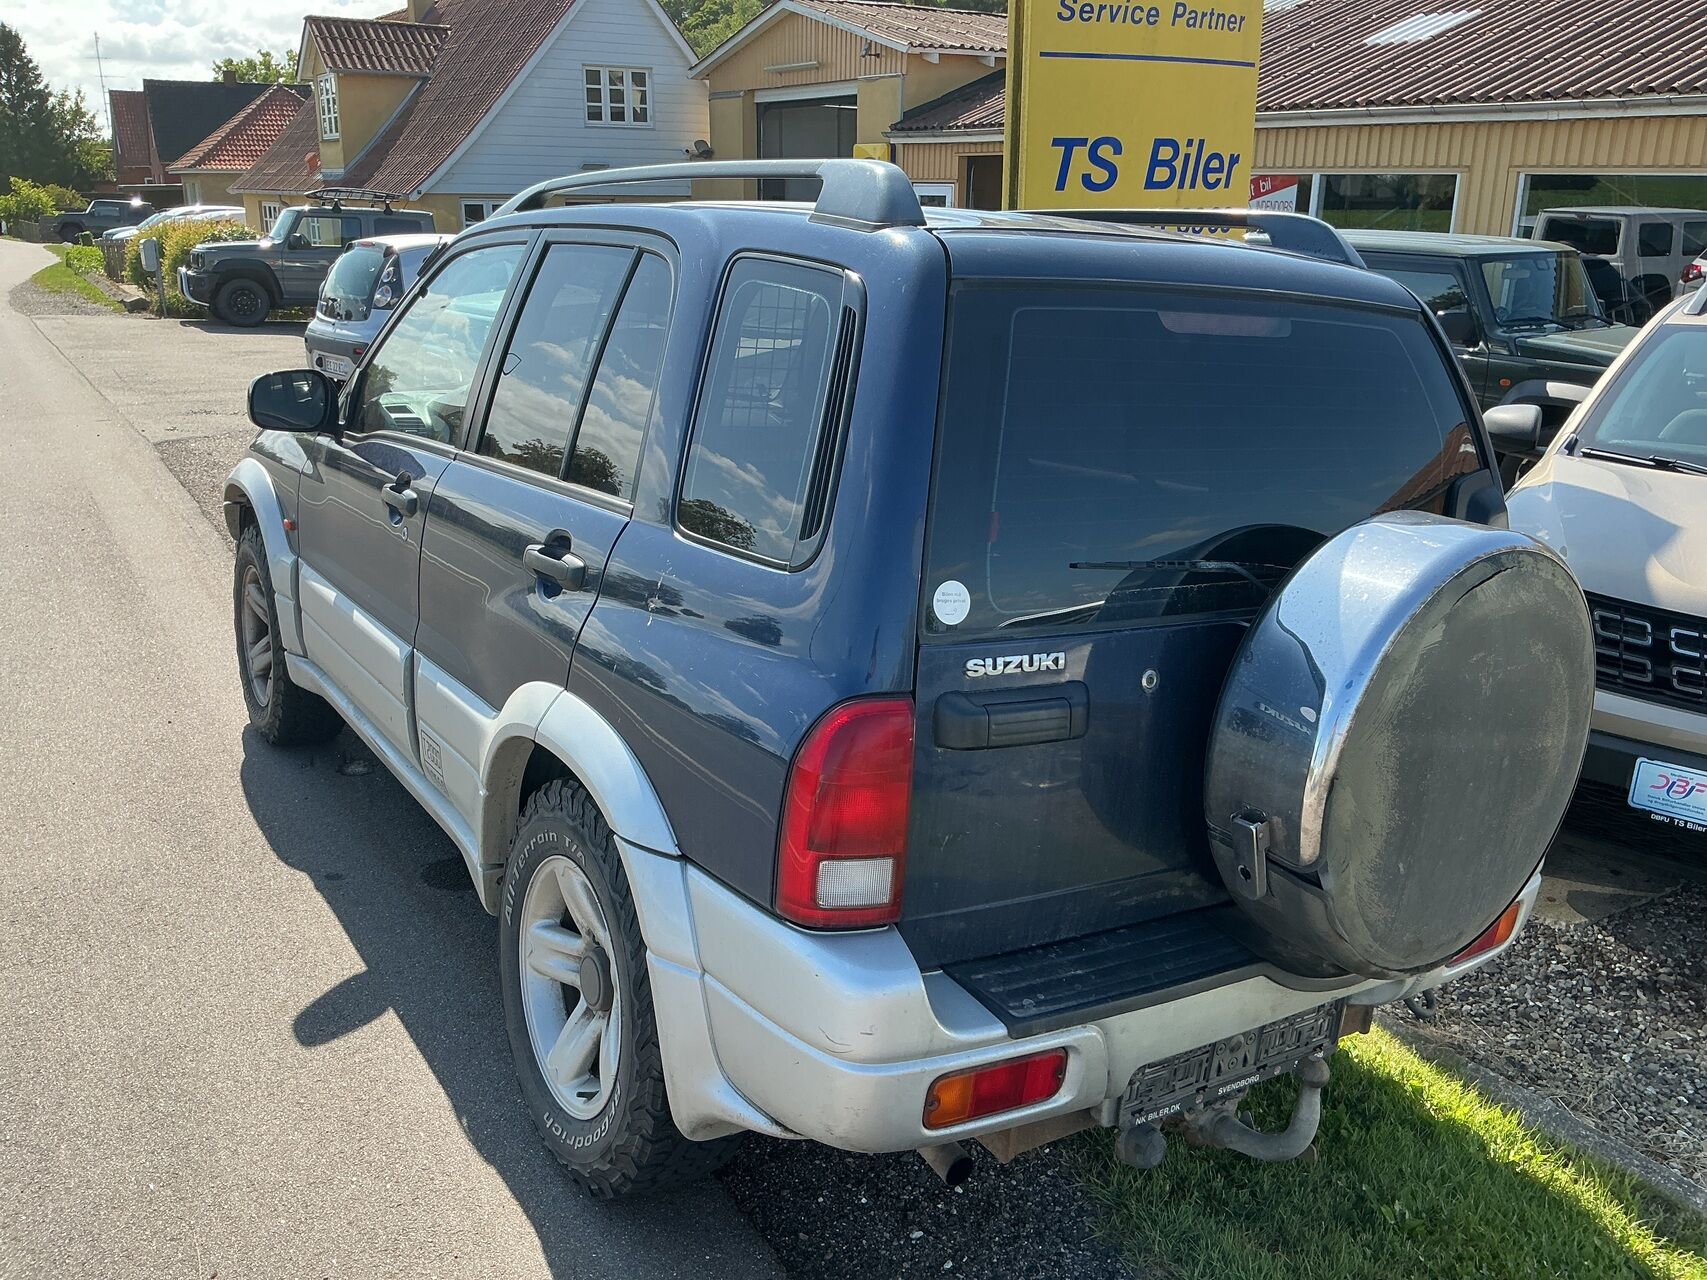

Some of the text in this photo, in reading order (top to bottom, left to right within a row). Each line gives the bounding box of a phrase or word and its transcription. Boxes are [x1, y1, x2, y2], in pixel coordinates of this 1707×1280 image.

[1057, 0, 1246, 33] Service Partner
[1051, 136, 1241, 192] TS Biler
[1260, 176, 1272, 193] bil
[965, 651, 1066, 678] SUZUKI
[1673, 818, 1685, 828] TS
[1686, 822, 1707, 833] Biler
[504, 829, 586, 927] All-Terrain T/A
[1217, 1074, 1260, 1095] SVENDBORG
[1135, 1102, 1182, 1126] NK BILER.DK
